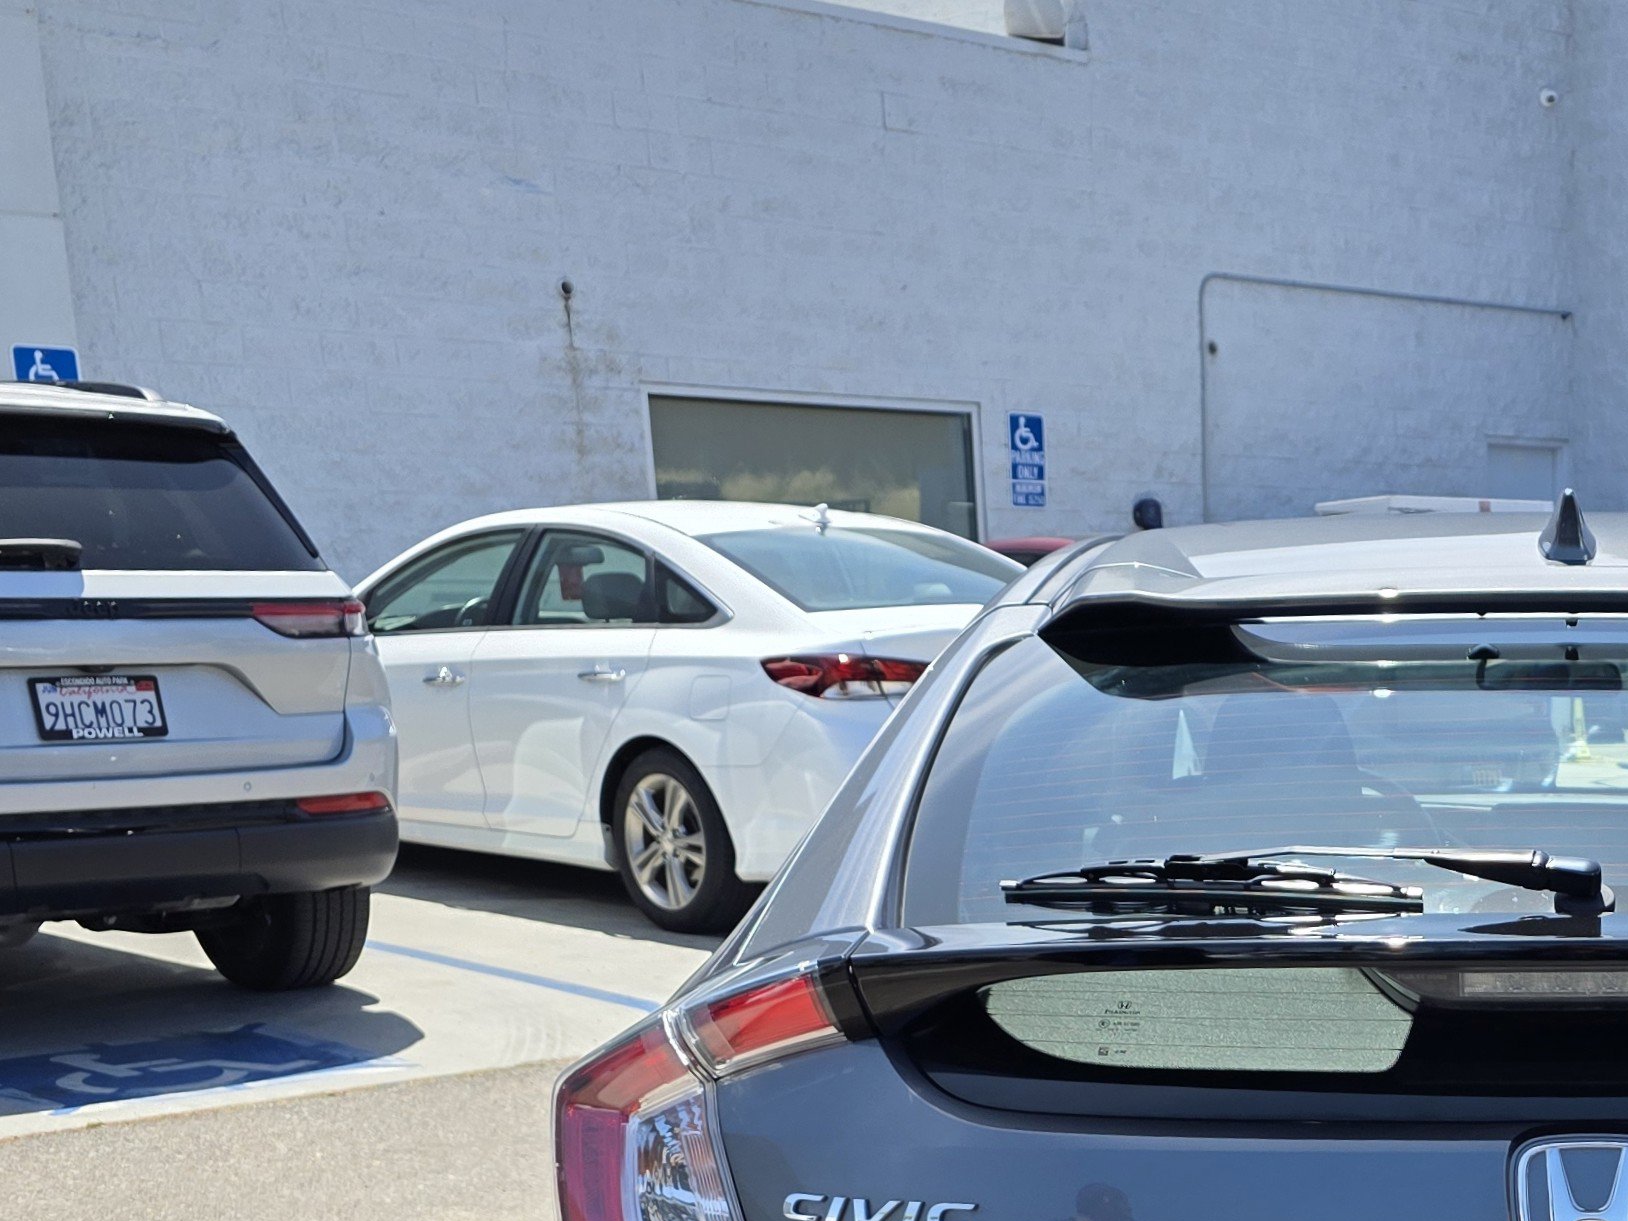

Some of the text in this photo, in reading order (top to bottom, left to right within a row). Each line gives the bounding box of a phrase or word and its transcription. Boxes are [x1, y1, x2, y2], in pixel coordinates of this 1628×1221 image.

[1011, 450, 1045, 465] PARKING
[1017, 464, 1039, 479] ONLY
[45, 700, 156, 731] 9HCM073
[72, 726, 144, 739] POWELL
